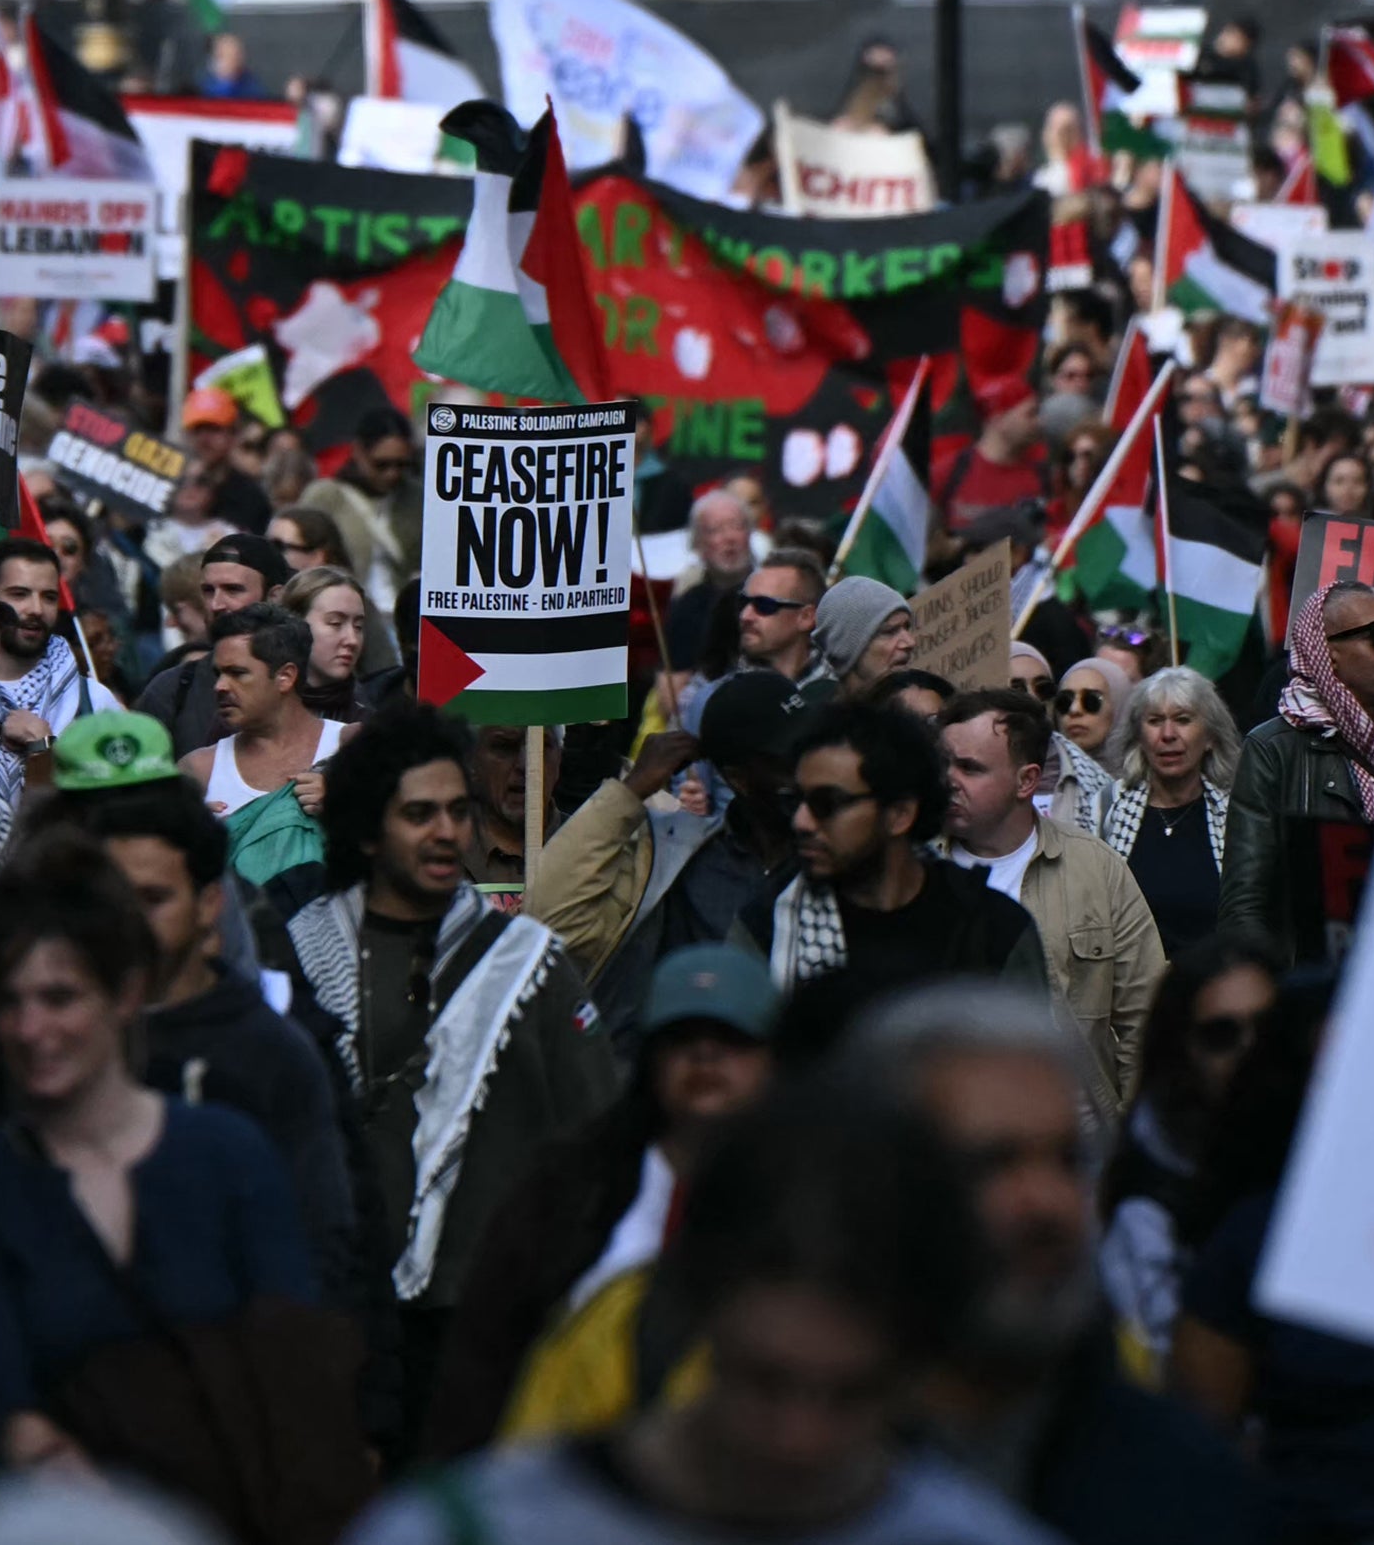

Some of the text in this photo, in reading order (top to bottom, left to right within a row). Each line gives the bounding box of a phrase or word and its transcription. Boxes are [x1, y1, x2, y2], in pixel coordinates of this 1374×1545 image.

[209, 192, 464, 262] ARTIST
[1292, 257, 1361, 281] Stp
[462, 409, 626, 431] PALESTINE SOLIDARITY CAMPAIGN
[48, 430, 175, 514] GENOCIDE
[436, 440, 626, 504] CEASEFIRE
[456, 502, 610, 589] NOW!
[428, 591, 457, 610] FREE
[461, 592, 529, 611] PALESTINE
[541, 592, 564, 610] END
[566, 586, 625, 609] APARTHEID
